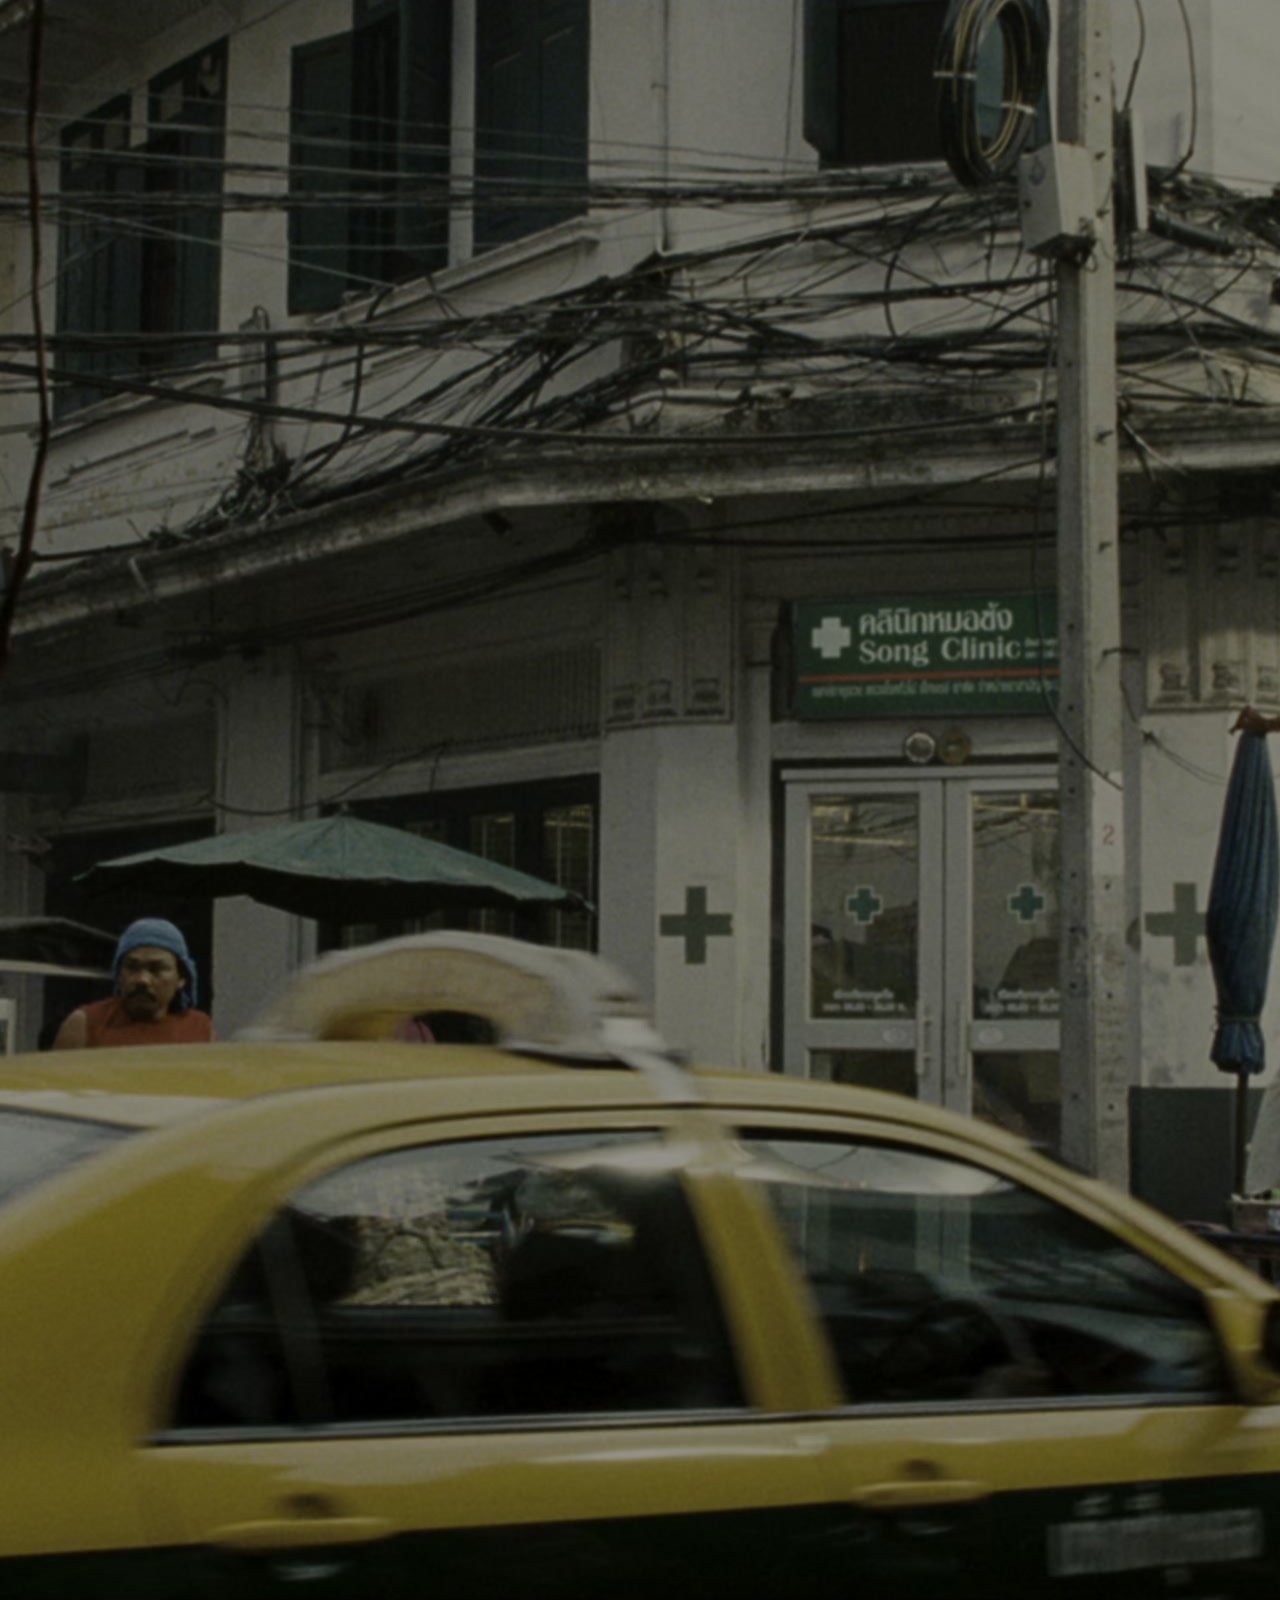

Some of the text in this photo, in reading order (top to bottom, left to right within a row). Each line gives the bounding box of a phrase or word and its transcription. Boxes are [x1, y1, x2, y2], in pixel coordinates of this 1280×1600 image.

[859, 635, 1022, 667] Song Clinic
[1103, 823, 1116, 846] 2
